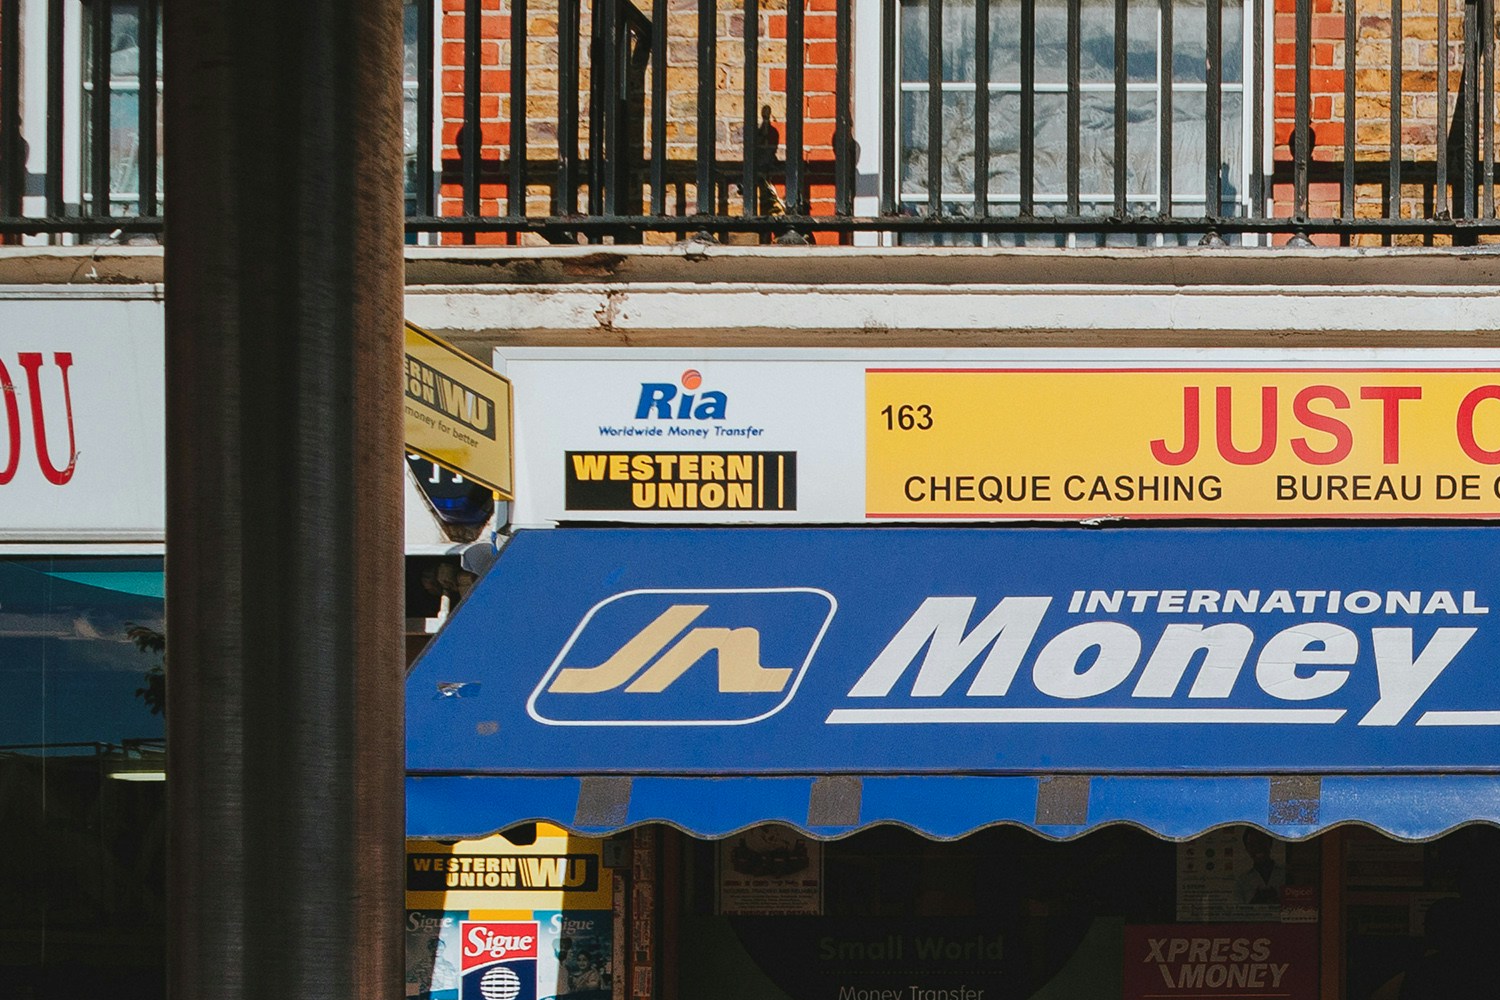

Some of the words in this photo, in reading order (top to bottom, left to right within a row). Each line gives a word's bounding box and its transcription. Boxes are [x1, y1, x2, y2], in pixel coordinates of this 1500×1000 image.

[634, 369, 728, 421] Ria
[598, 425, 663, 437] Worldwide
[667, 425, 710, 439] Money
[714, 425, 765, 439] Transfer
[880, 404, 934, 432] 163
[1149, 384, 1423, 468] JUST
[571, 454, 754, 482] WESTERN
[631, 482, 754, 509] UNION
[903, 474, 1057, 504] CHEQUE
[1062, 474, 1223, 503] CASHING
[1275, 474, 1422, 502] BUREAU
[1435, 474, 1481, 502] DE
[1067, 589, 1490, 616] INTERNATIONAL
[846, 595, 1480, 727] Money
[413, 857, 516, 873] WESTERN
[446, 872, 516, 888] UNION
[464, 926, 534, 959] Sigue
[1143, 937, 1272, 964] XPRESS
